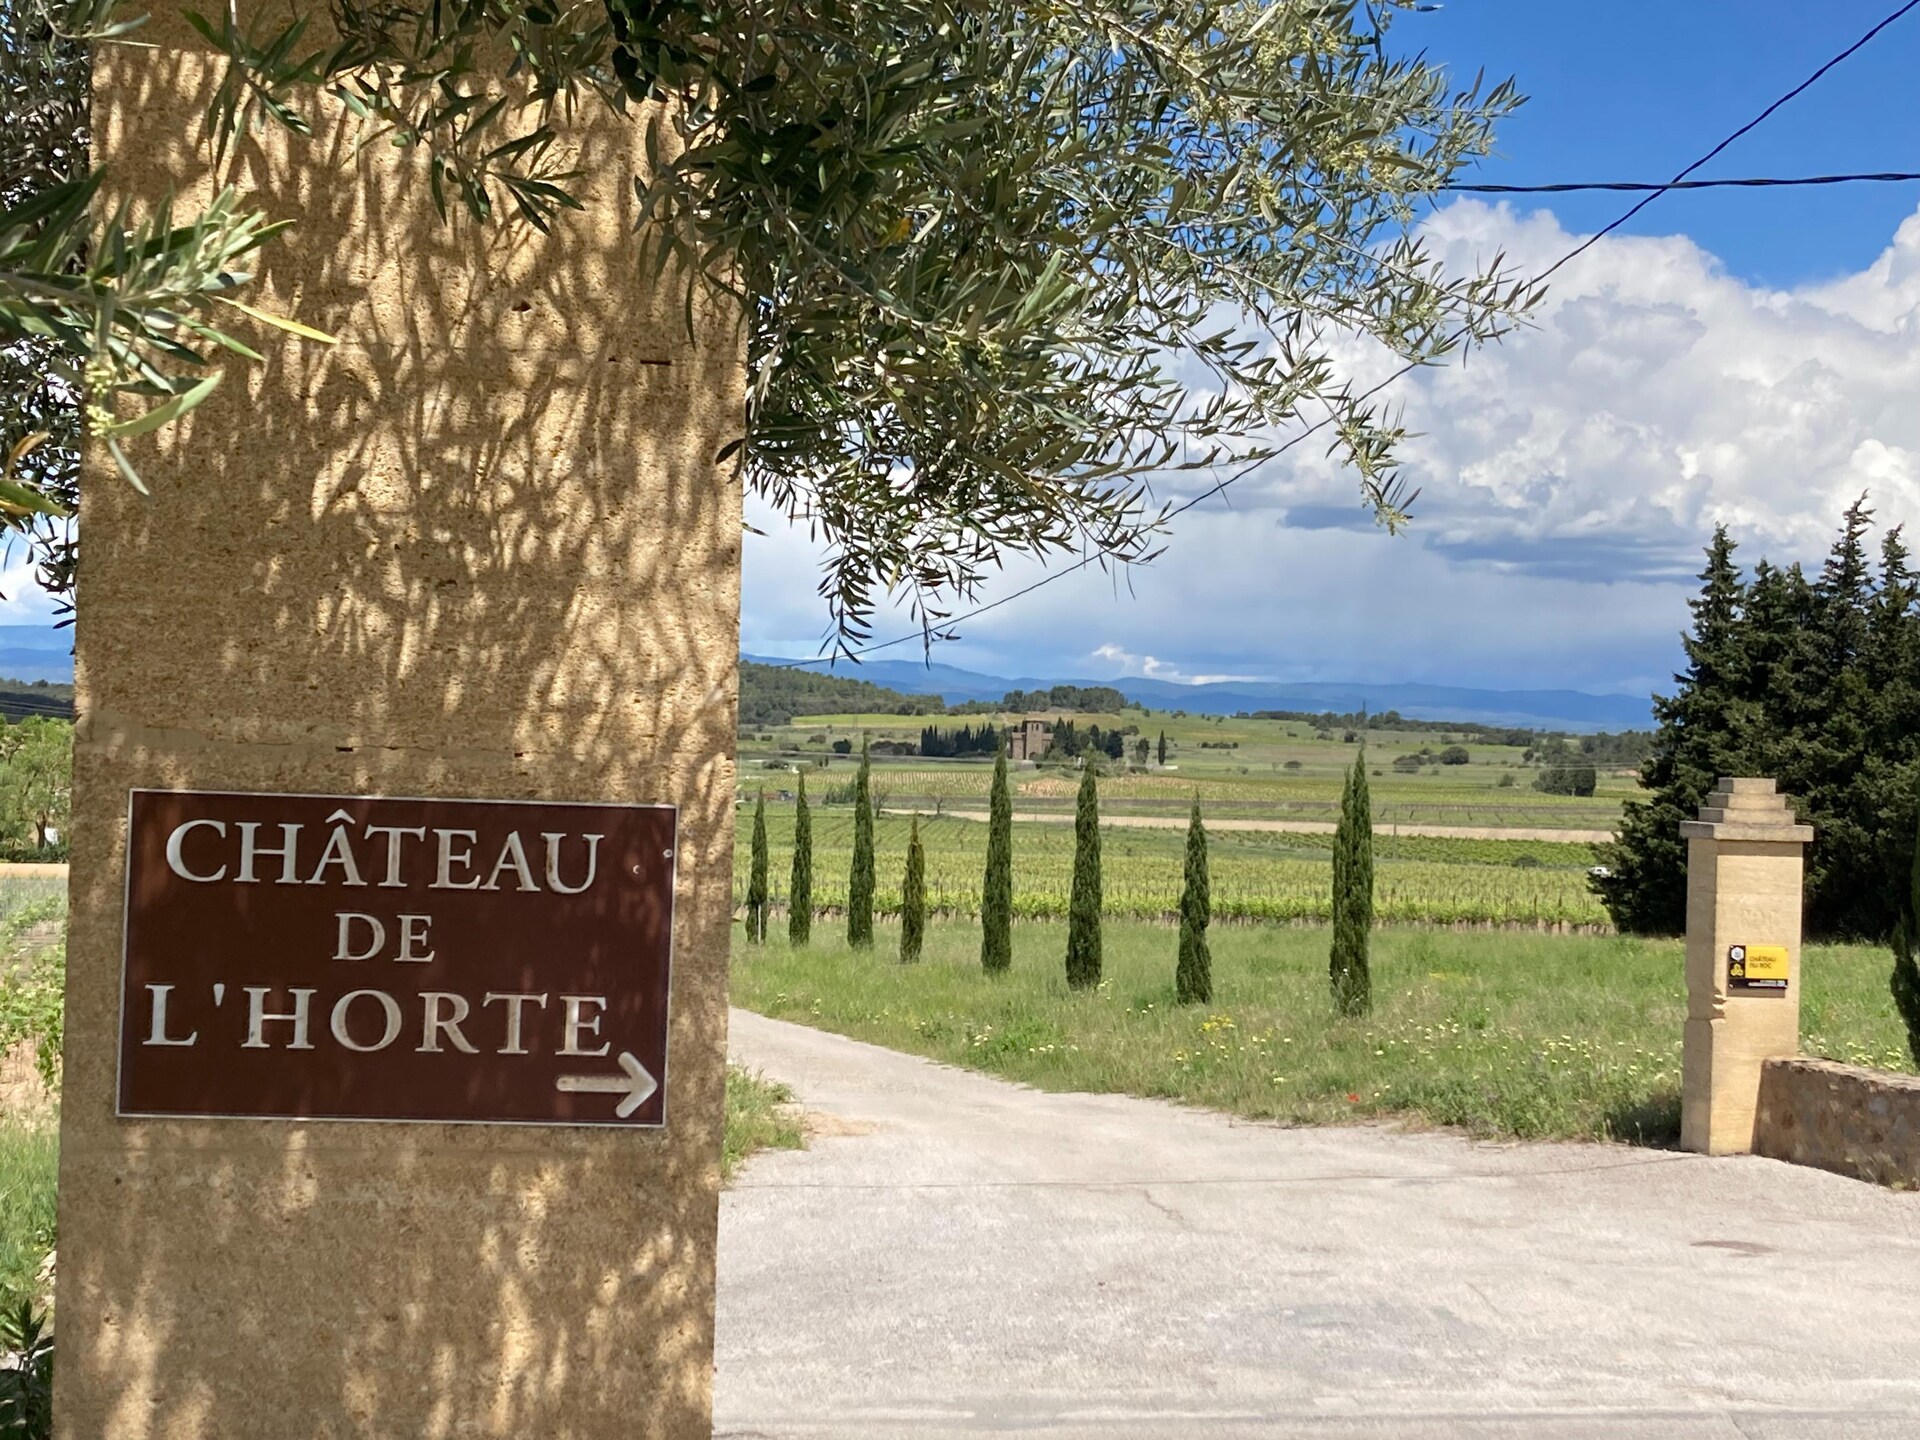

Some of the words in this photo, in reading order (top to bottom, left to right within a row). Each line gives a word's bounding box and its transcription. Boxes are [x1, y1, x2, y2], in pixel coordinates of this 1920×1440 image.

[166, 808, 604, 895] CHÂTEAU
[333, 912, 435, 963] DE
[142, 983, 611, 1057] L'HORTE
